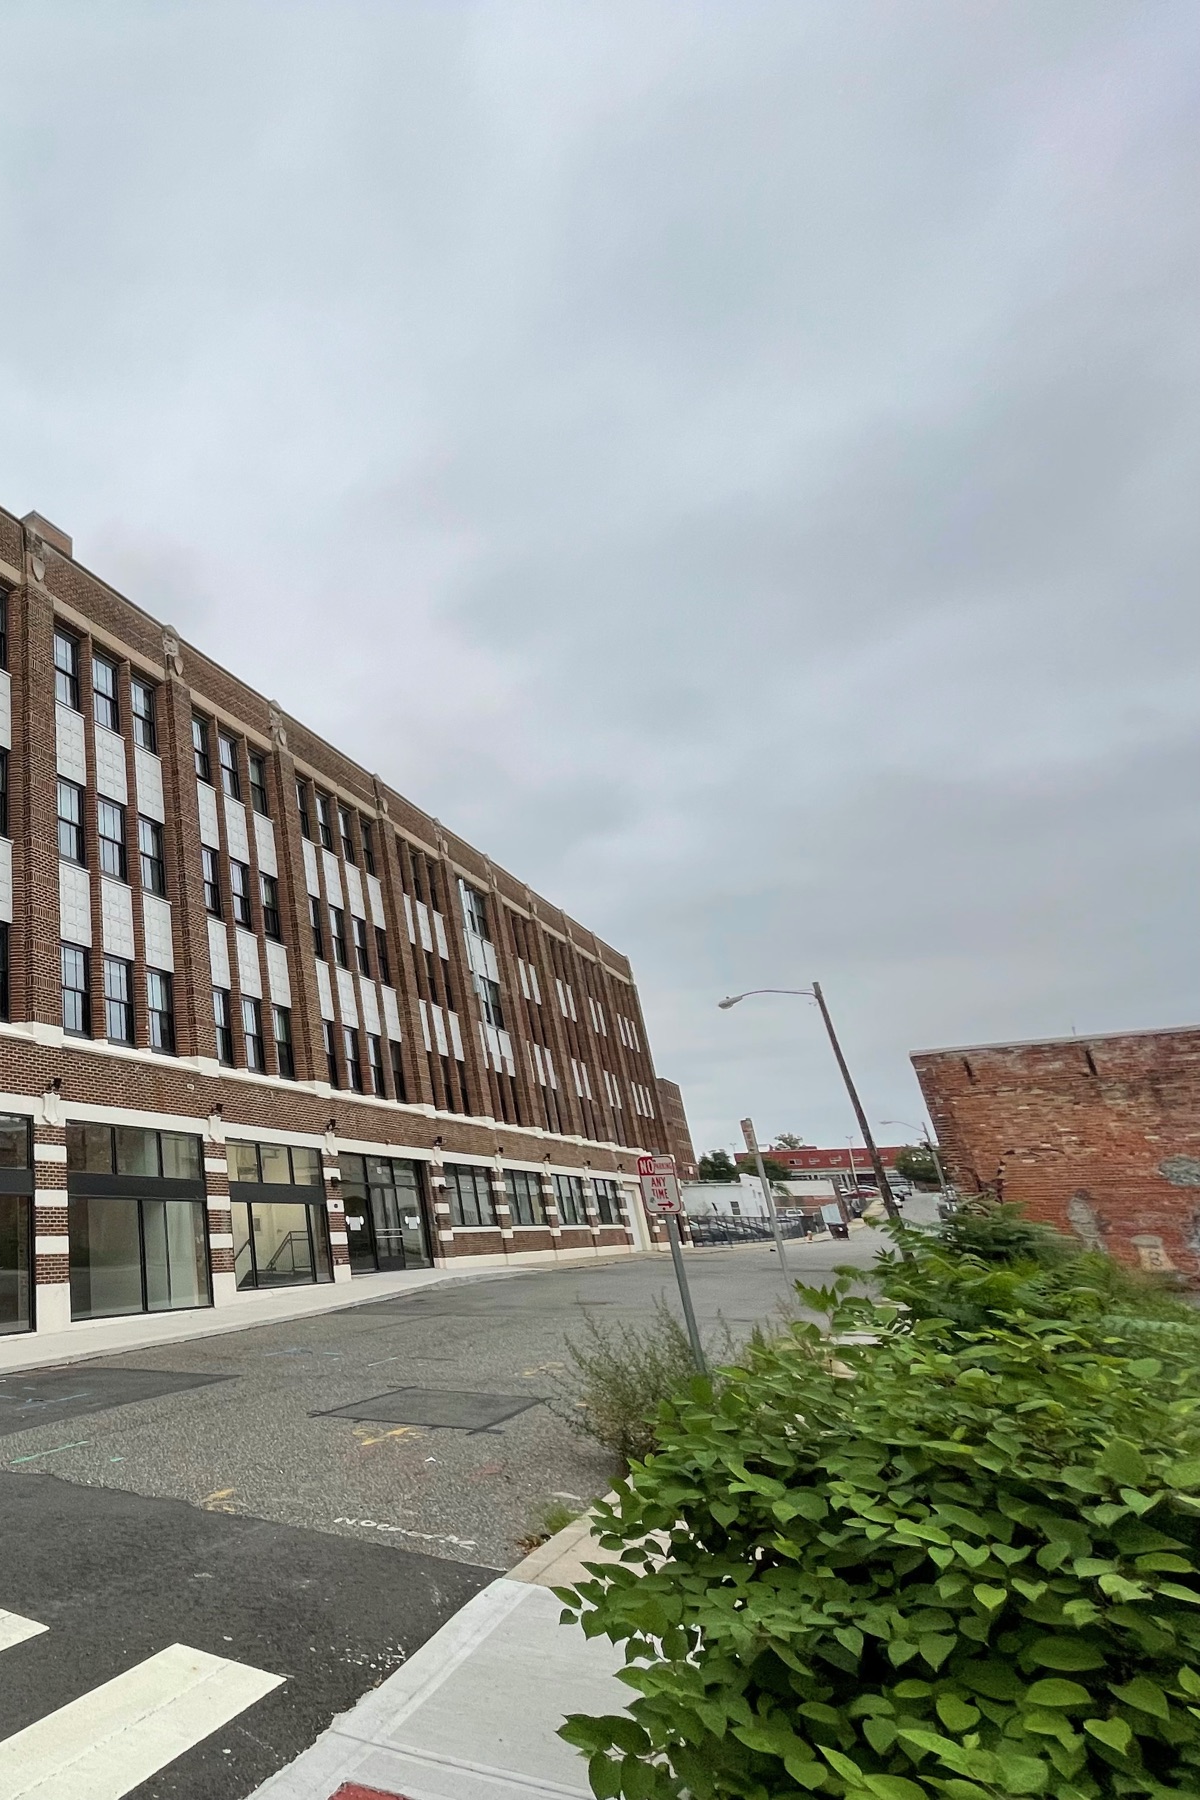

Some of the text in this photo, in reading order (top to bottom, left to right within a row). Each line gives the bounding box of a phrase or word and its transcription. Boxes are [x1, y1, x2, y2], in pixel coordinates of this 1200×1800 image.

[639, 1159, 654, 1174] NO
[651, 1177, 666, 1187] ANY
[651, 1189, 669, 1199] TIME
